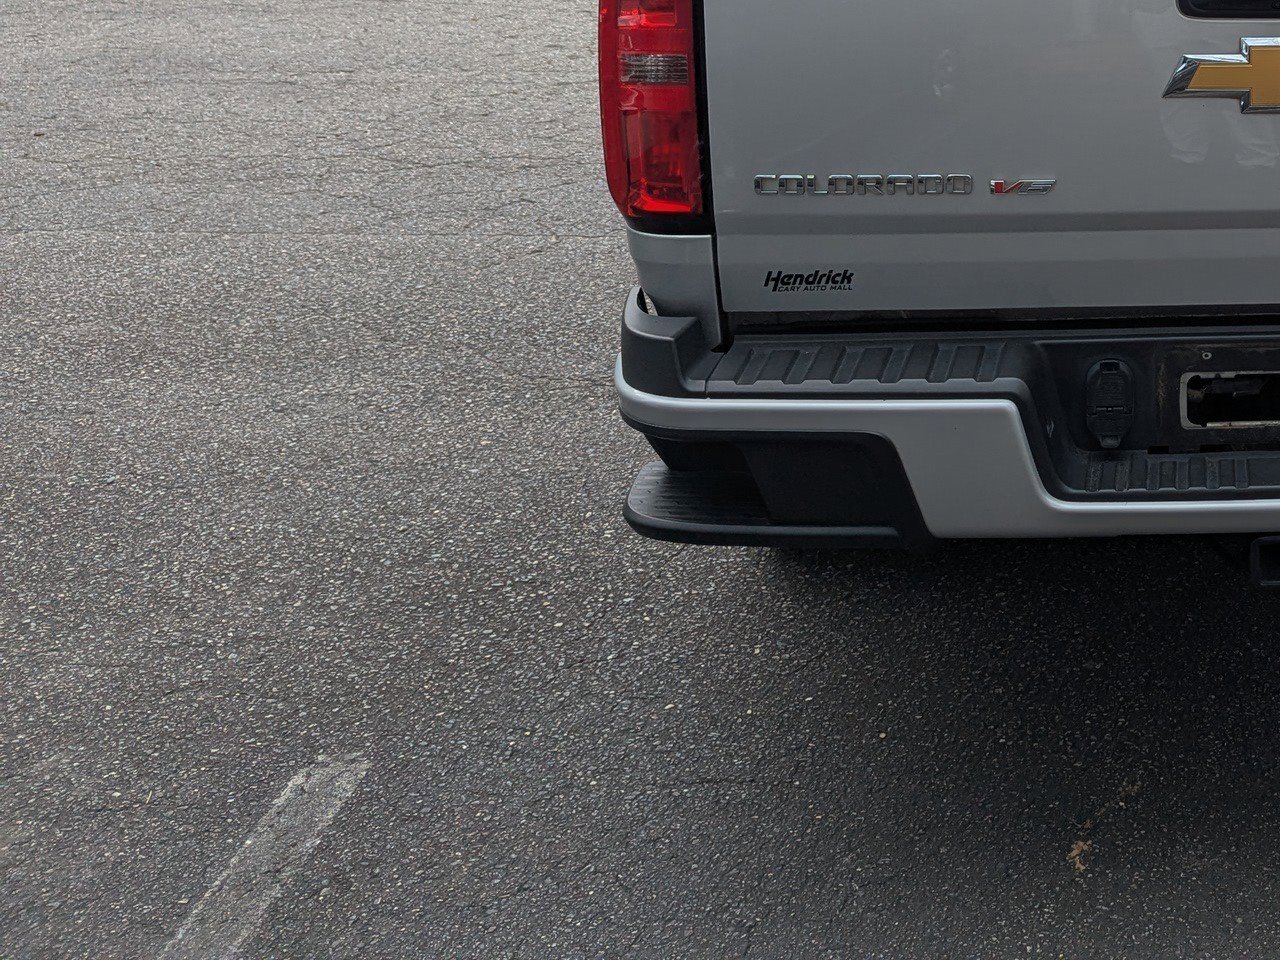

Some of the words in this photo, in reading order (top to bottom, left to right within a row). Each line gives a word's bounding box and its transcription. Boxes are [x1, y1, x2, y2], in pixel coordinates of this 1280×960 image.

[753, 173, 974, 196] COLORADO
[990, 179, 1056, 195] V6
[763, 269, 855, 292] Hendrick
